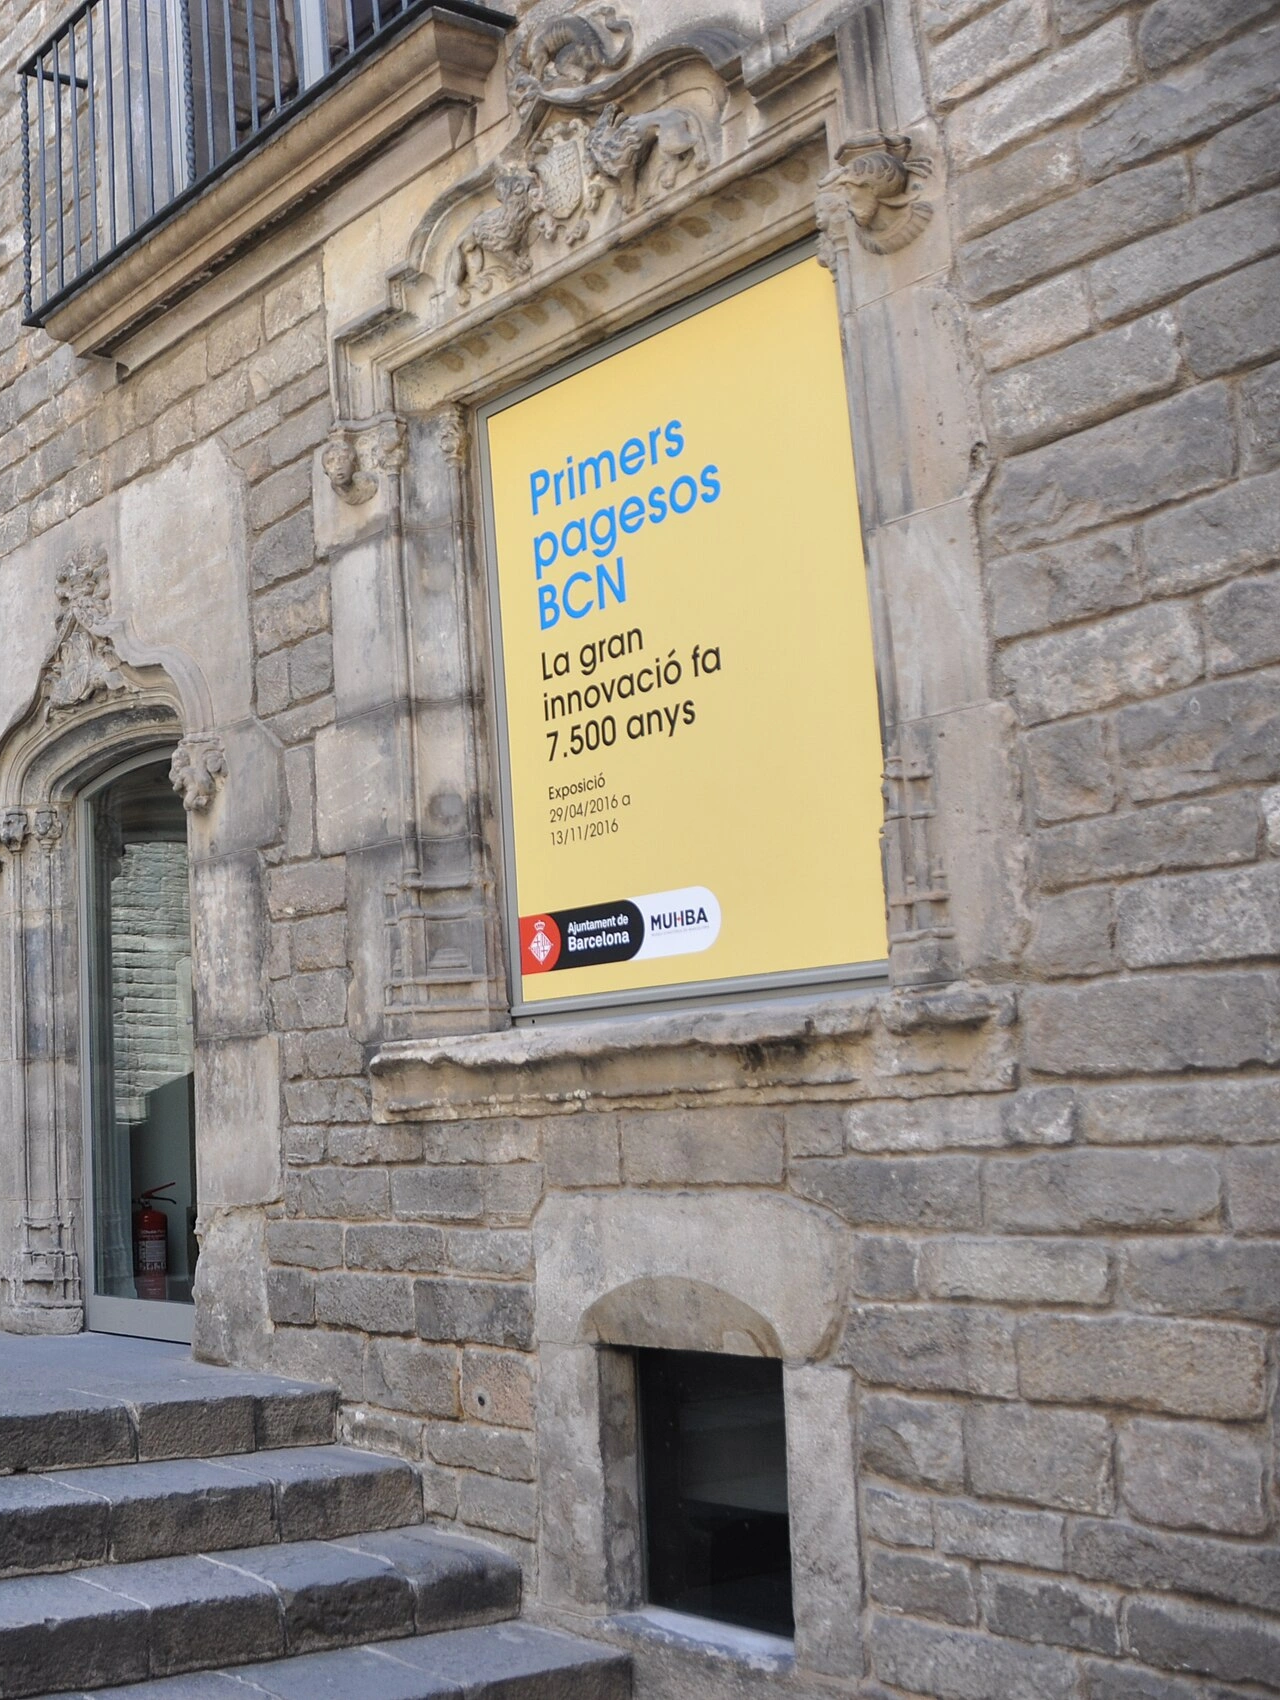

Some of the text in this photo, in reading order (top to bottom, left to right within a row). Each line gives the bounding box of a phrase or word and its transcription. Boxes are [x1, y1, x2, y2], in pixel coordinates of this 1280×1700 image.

[529, 419, 685, 516] Primers
[533, 463, 722, 581] pagesos
[537, 556, 627, 631] BCN
[541, 628, 643, 681] La gran
[543, 644, 722, 722] innovació fa
[546, 699, 696, 762] 7.500 anys
[548, 772, 606, 801] Exposició
[549, 794, 631, 824] 29/04/2016 a
[551, 818, 619, 846] 13/11/2016
[567, 913, 629, 936] Ajuntament de
[650, 907, 709, 931] MUHBA
[567, 930, 630, 952] Barcelona
